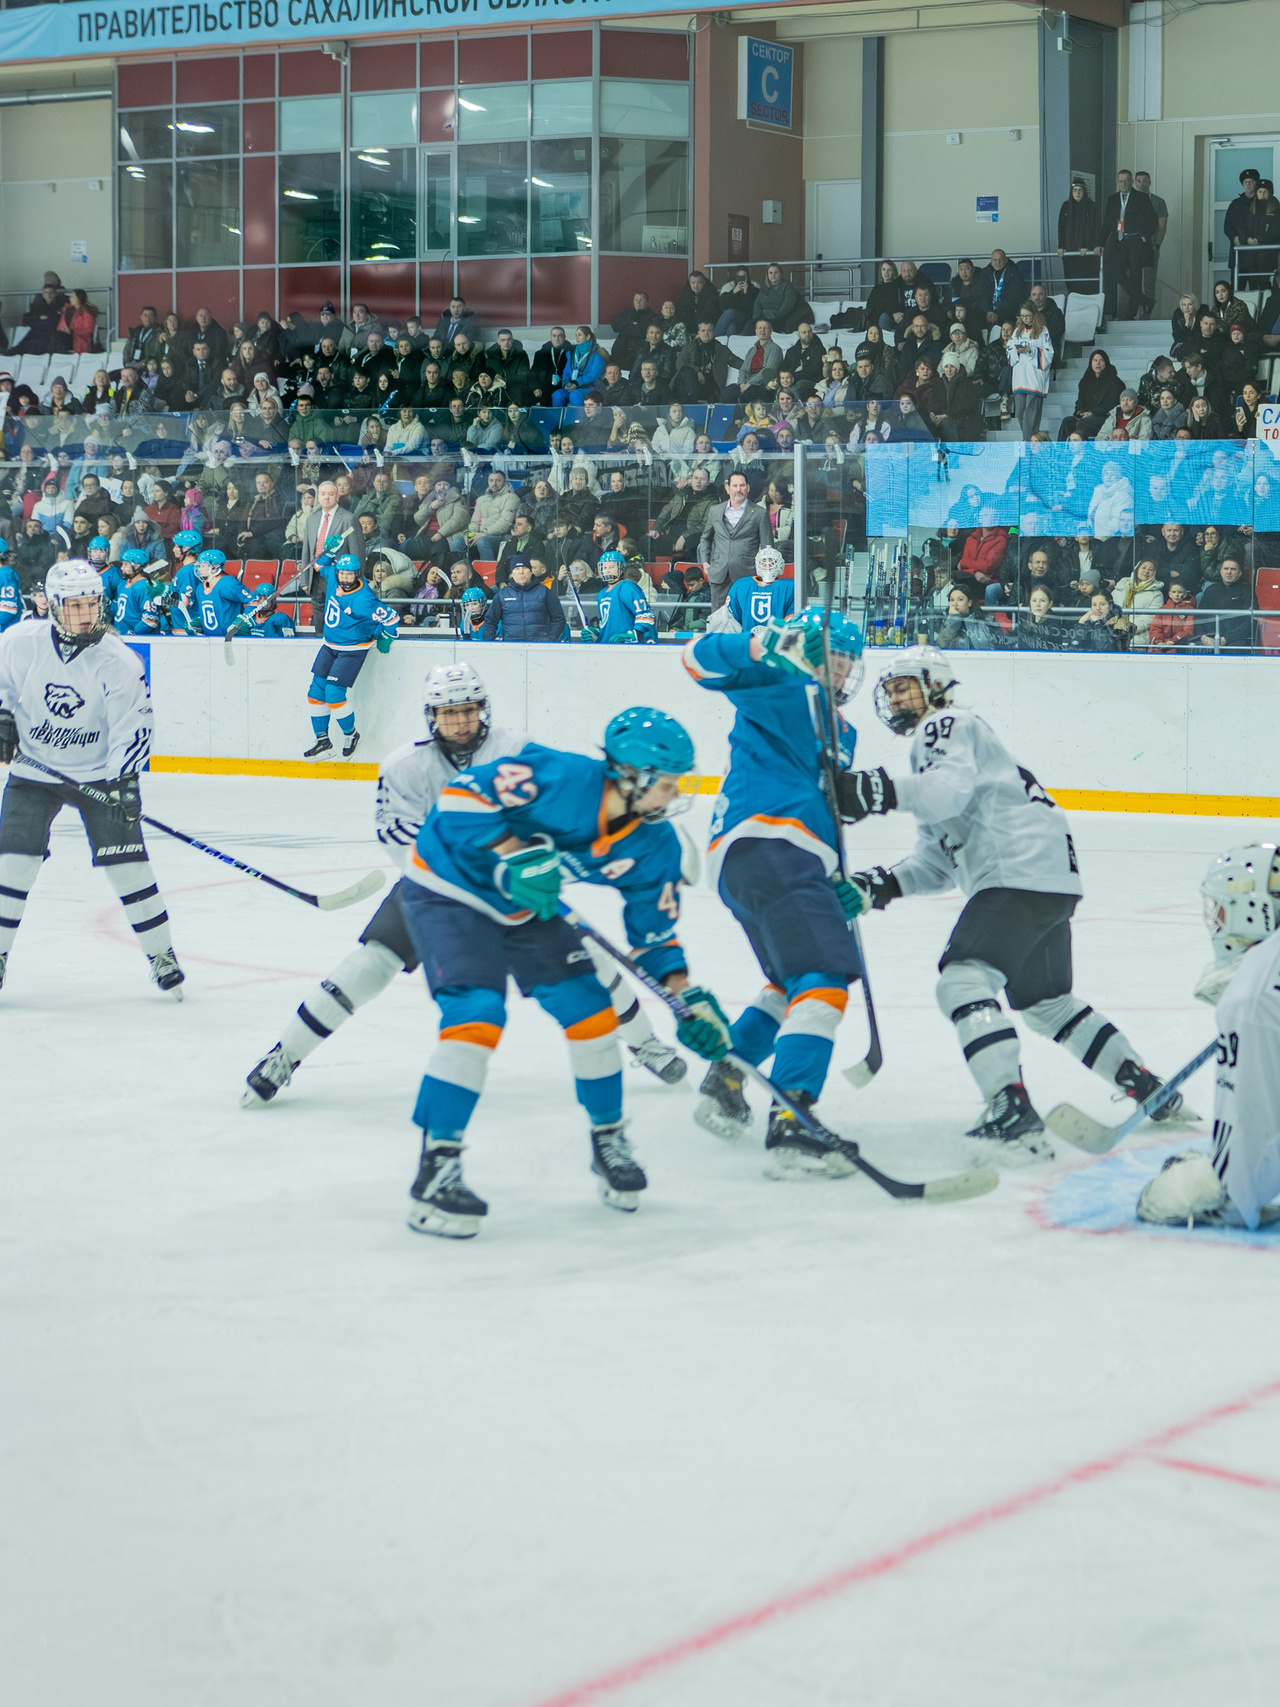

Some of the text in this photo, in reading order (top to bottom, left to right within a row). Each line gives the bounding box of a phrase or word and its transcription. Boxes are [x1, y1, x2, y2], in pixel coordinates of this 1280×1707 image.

[78, 0, 279, 42] ПРАВИТЕЛЬСТВО
[752, 43, 790, 64] СЕКТОР
[750, 101, 788, 123] SECTOR
[0, 586, 15, 599] 13
[372, 606, 388, 622] 43
[633, 599, 648, 613] 17
[924, 716, 955, 748] 98
[97, 843, 144, 857] BAUER
[658, 880, 681, 920] 4
